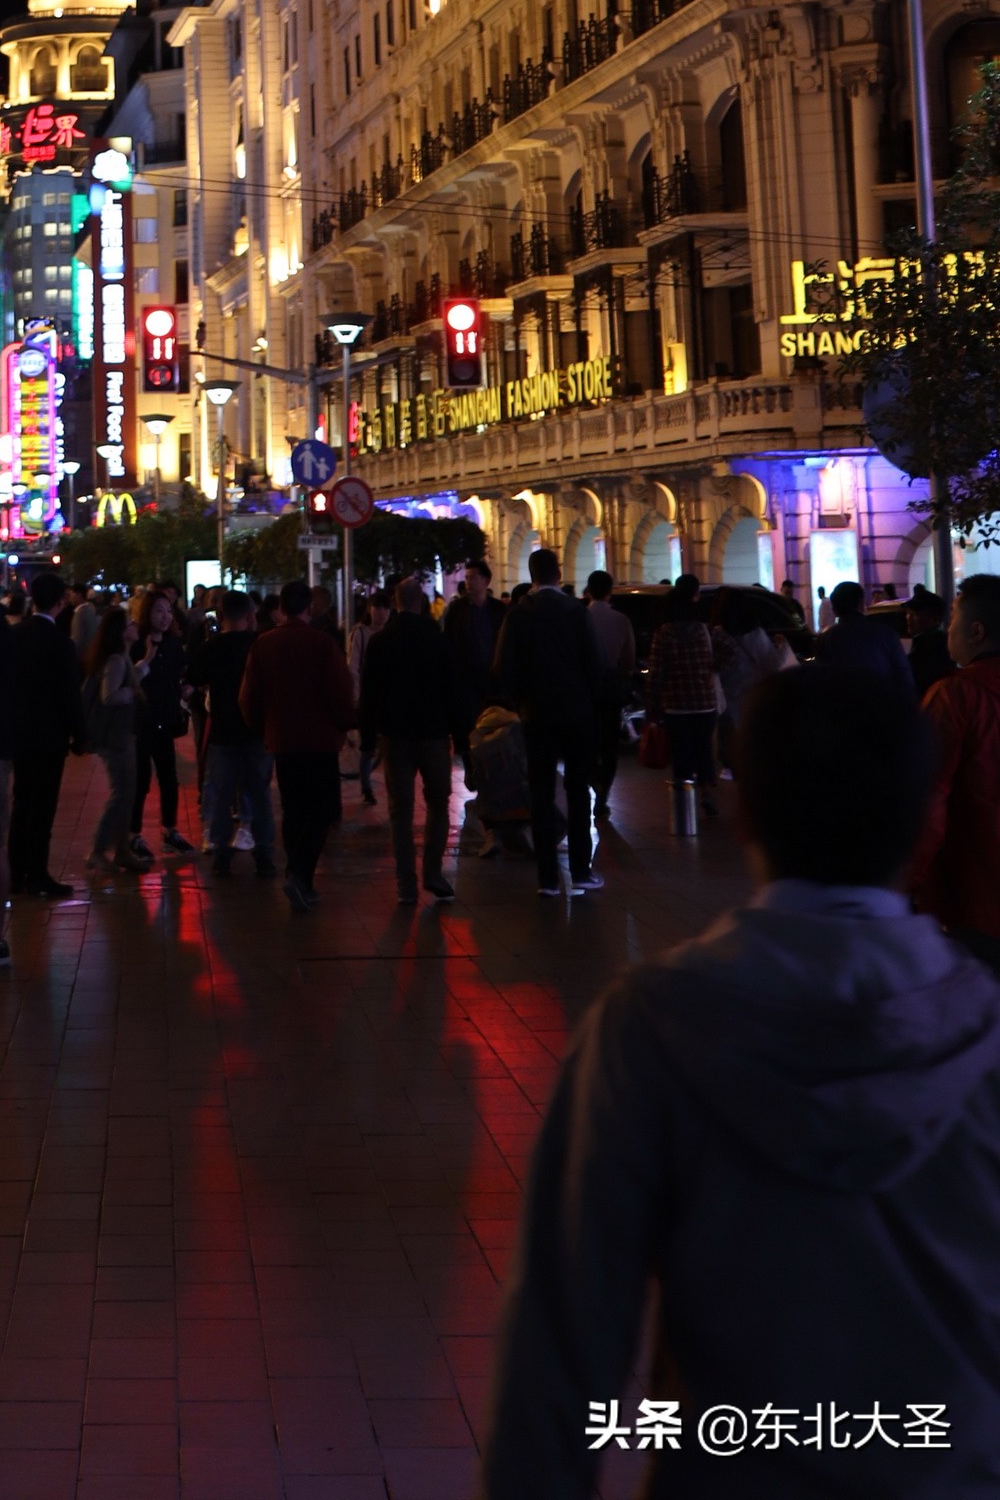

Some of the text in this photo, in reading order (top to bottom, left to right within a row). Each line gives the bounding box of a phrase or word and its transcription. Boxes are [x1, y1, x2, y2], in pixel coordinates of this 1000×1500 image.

[449, 386, 502, 431] SHANGHAI
[506, 370, 559, 418] FASHION
[567, 356, 613, 403] STORE
